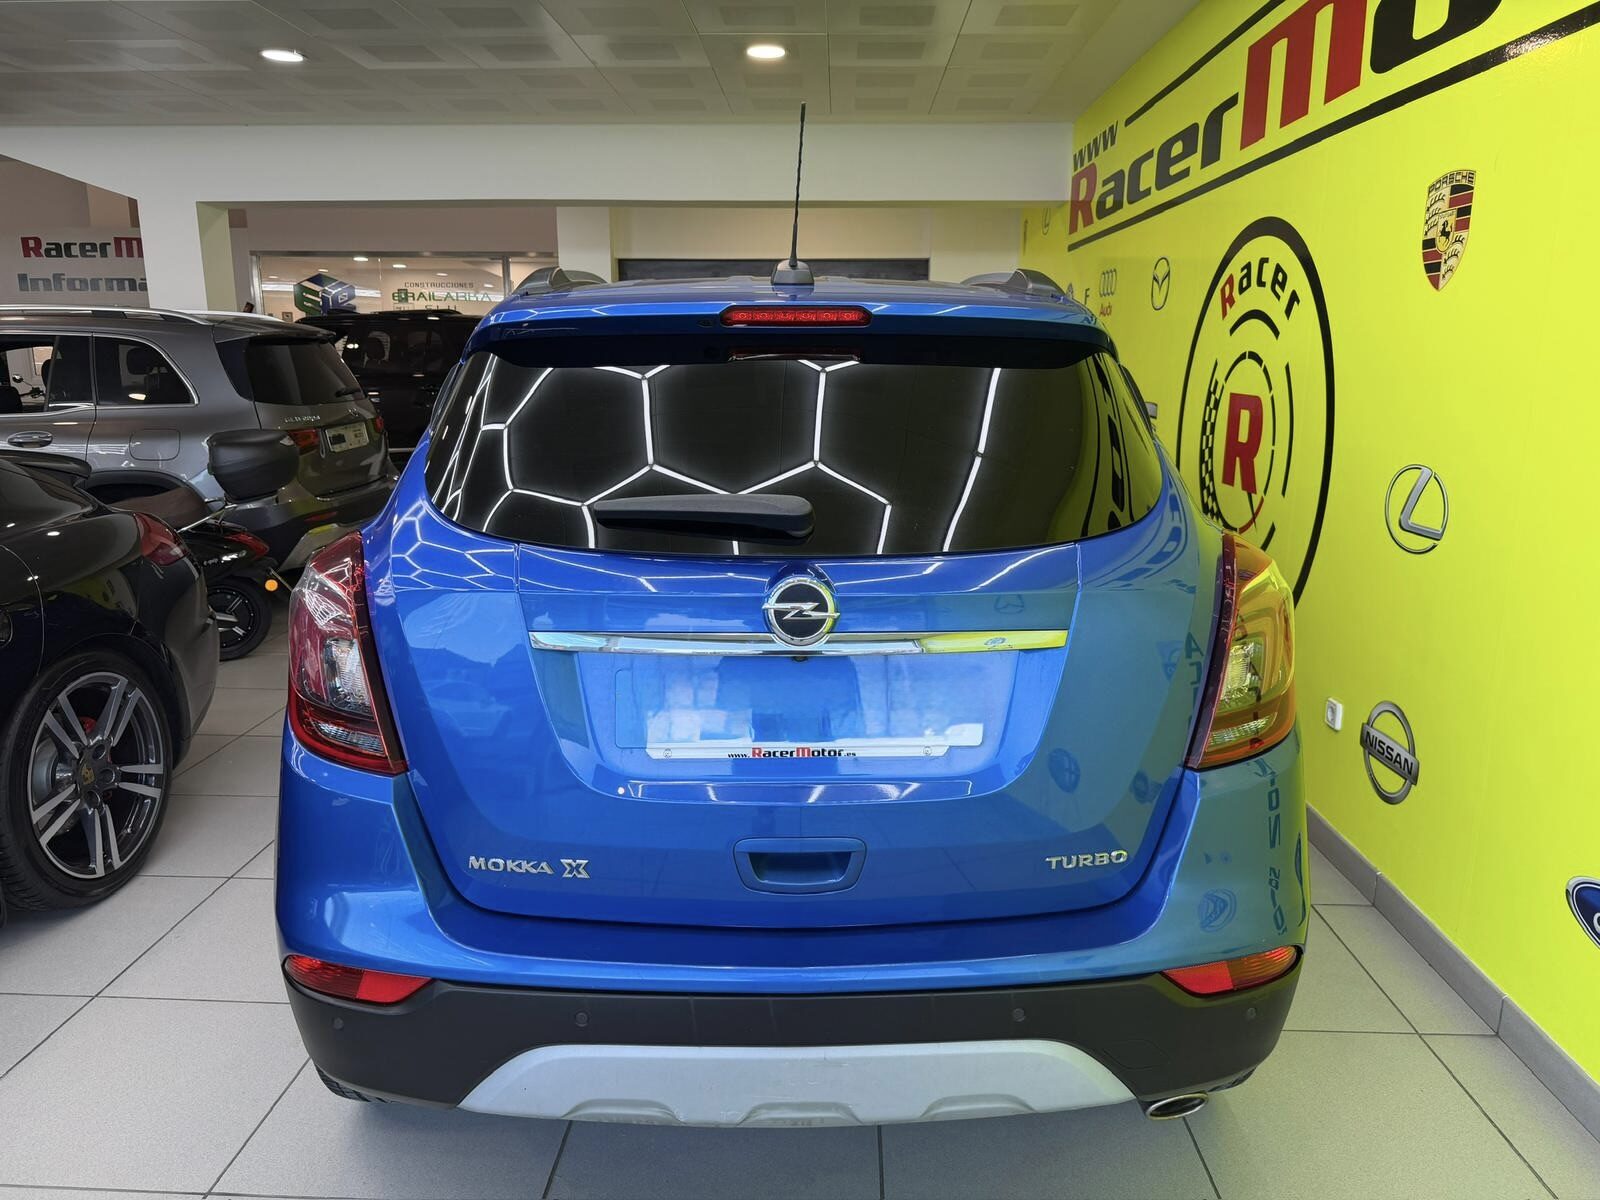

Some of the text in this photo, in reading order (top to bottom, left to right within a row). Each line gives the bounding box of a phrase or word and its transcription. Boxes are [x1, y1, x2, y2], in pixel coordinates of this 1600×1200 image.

[1427, 171, 1475, 195] PORSCHE
[1220, 256, 1301, 321] Racer
[1099, 302, 1112, 317] Audi
[1222, 392, 1264, 495] R
[1365, 730, 1414, 777] NISSAN
[468, 855, 591, 879] MOKKA X
[1045, 849, 1129, 870] TURBO
